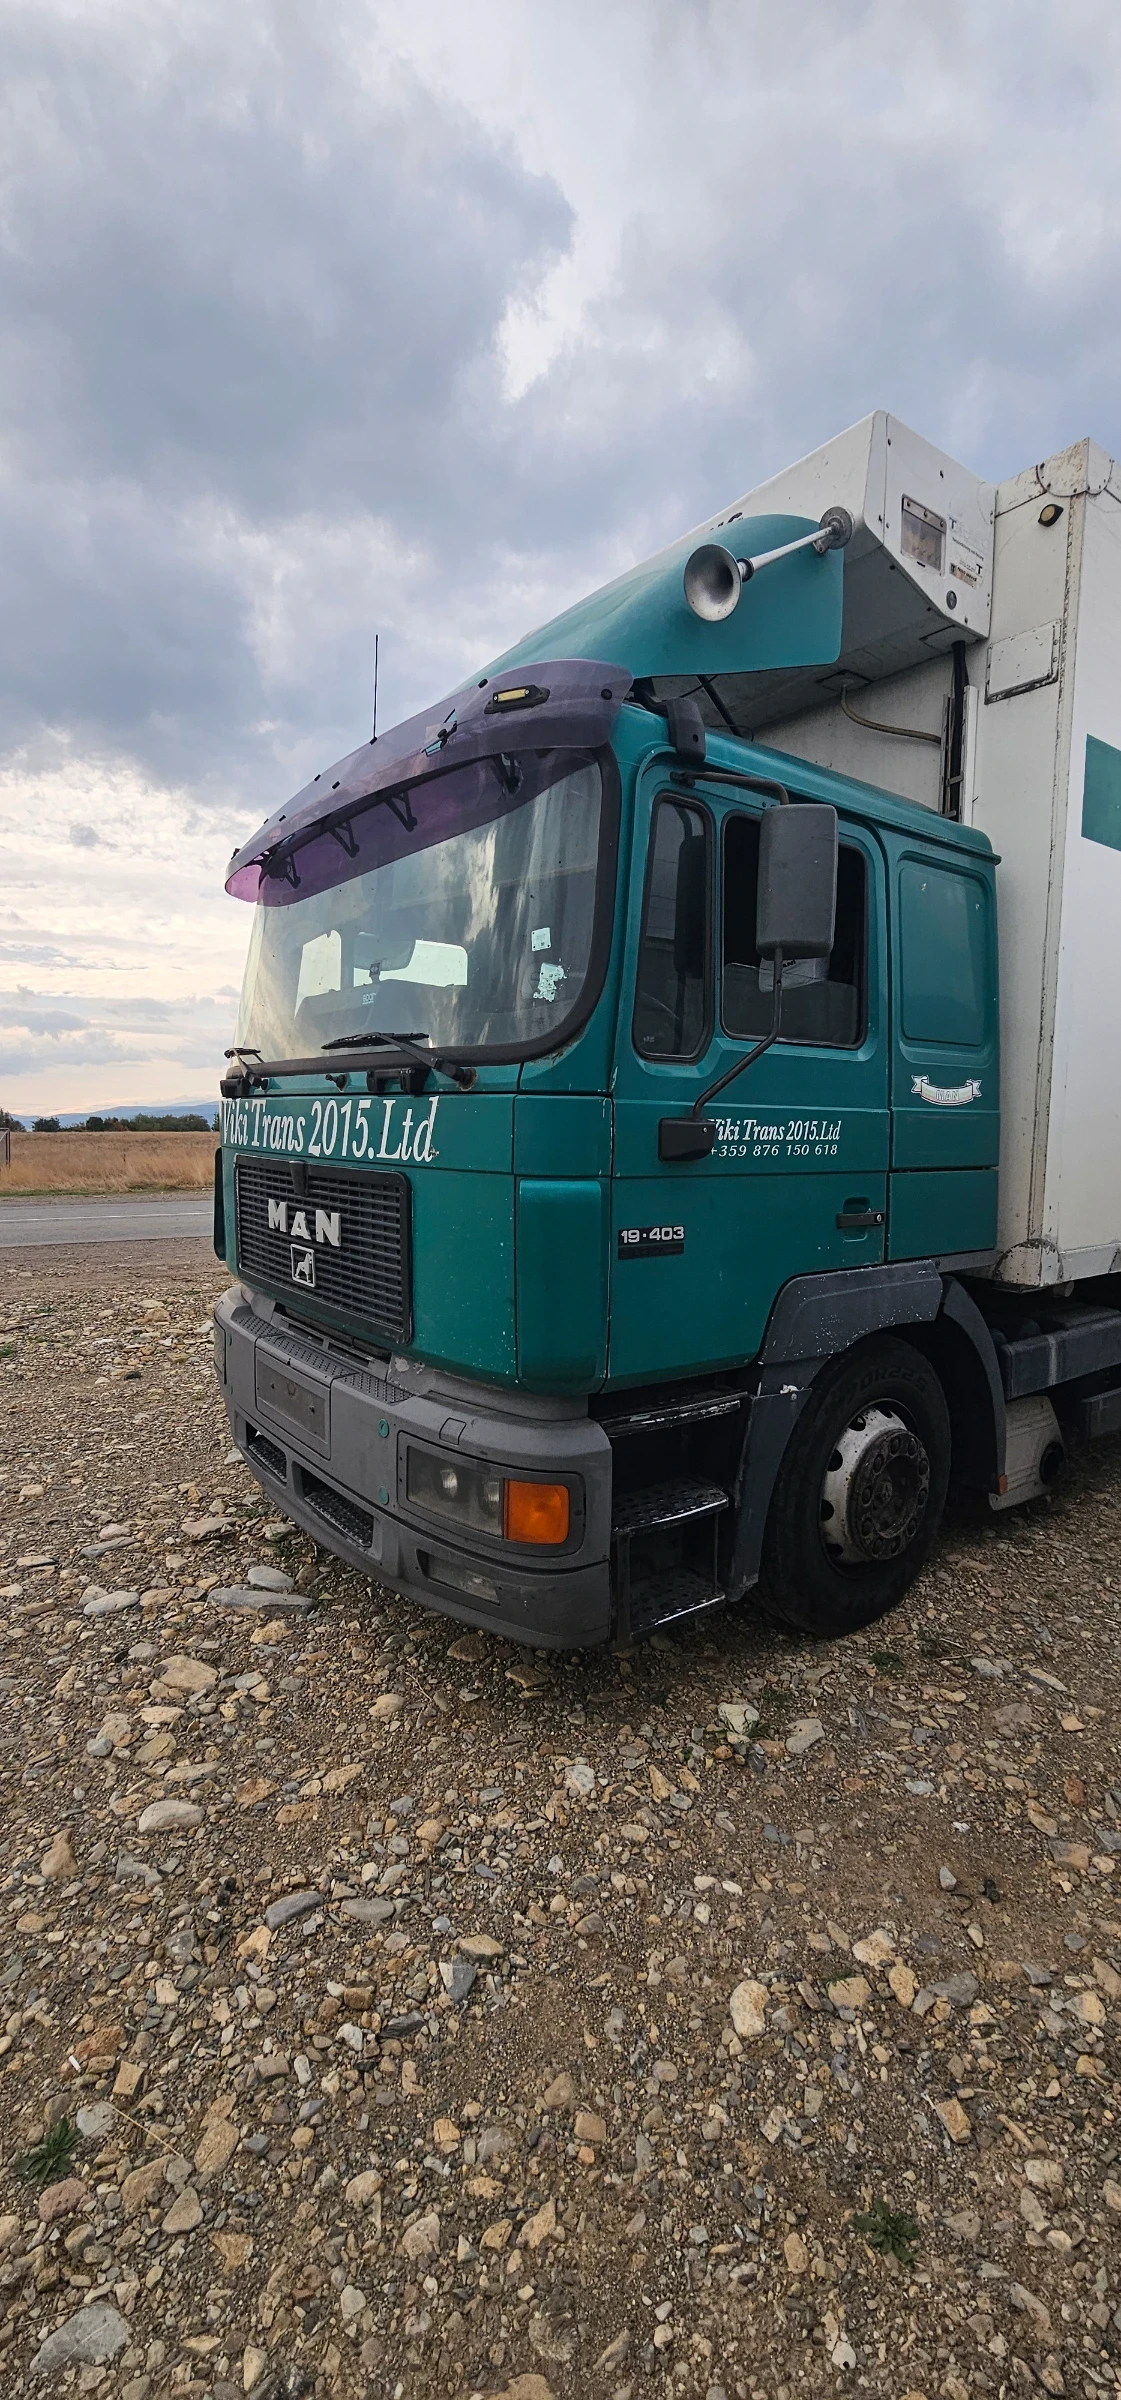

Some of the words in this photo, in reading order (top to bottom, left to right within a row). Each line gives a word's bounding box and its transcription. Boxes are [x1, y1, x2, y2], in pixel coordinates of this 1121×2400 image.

[935, 1089, 960, 1102] MAN
[221, 1097, 249, 1146] Viki
[251, 1099, 306, 1152] Trans
[742, 1119, 785, 1141] Trans
[786, 1119, 842, 1141] 2015.Ltd
[710, 1144, 747, 1157] +359
[752, 1144, 780, 1157] 876
[785, 1144, 810, 1156] 150
[814, 1144, 838, 1156] 618
[267, 1198, 342, 1247] MAN
